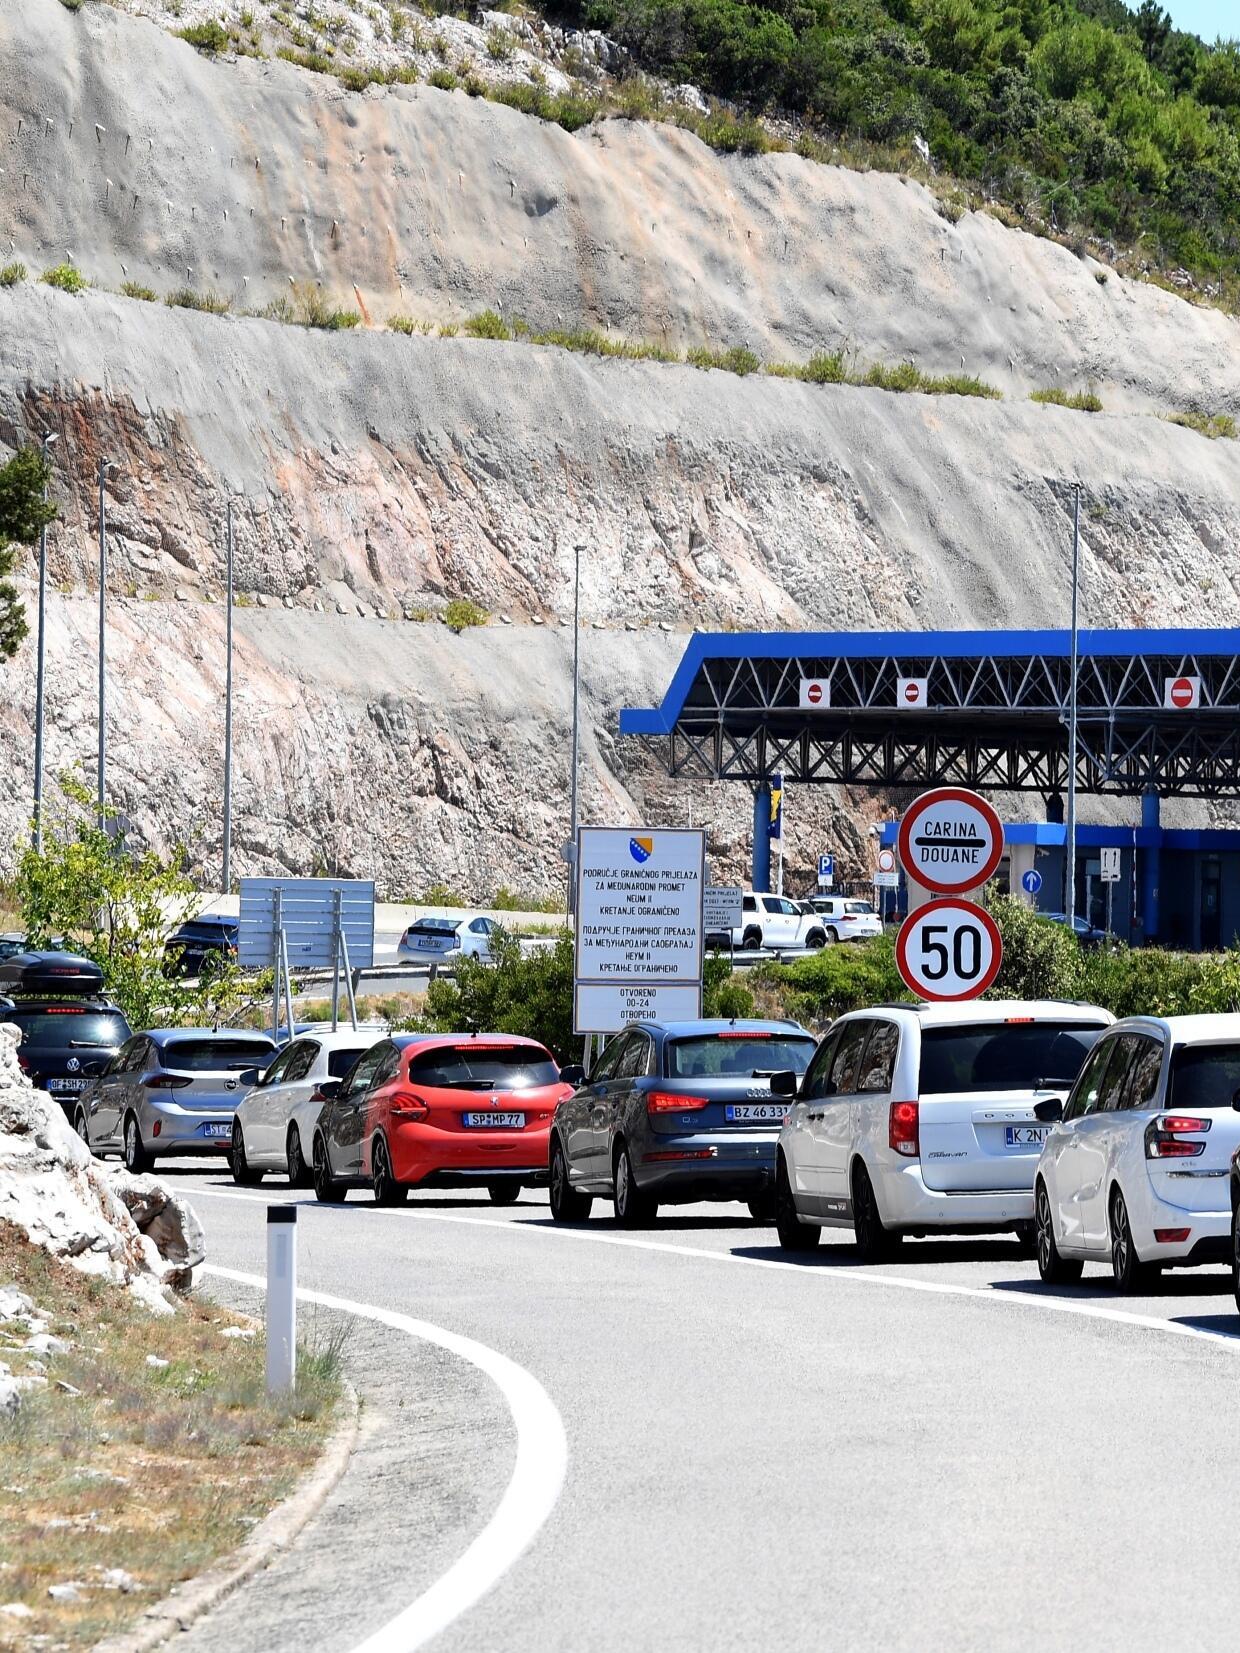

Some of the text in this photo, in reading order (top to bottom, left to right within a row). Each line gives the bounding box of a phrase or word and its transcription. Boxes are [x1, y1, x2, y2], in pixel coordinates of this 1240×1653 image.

[924, 821, 977, 838] CARINA
[921, 847, 979, 864] DOUANE
[821, 857, 831, 871] P
[661, 870, 698, 880] PRIJELAZA
[595, 881, 605, 891] ZA
[658, 882, 686, 892] PROMET
[626, 894, 646, 903] NEUM
[600, 906, 636, 916] KRETANJE
[583, 925, 696, 936] ПОДРУЧЈЕ ГРАНИЧНОГ ПРЕЛАЗА
[584, 938, 694, 949] ЗА МЕЂУНАРОДНИ САОБРАЋАЈ
[625, 951, 644, 961] НЕУМ
[921, 925, 982, 981] 50
[599, 963, 679, 974] КРЕТАЊЕ ОГРАНИЧЕНО
[619, 988, 657, 998] OTVORENO
[626, 998, 650, 1008] 00-24
[620, 1010, 657, 1019] ОТВОРЕНО
[734, 1106, 788, 1118] BZ 46 331
[472, 1114, 520, 1125] SP MP 77
[1014, 1129, 1022, 1142] K
